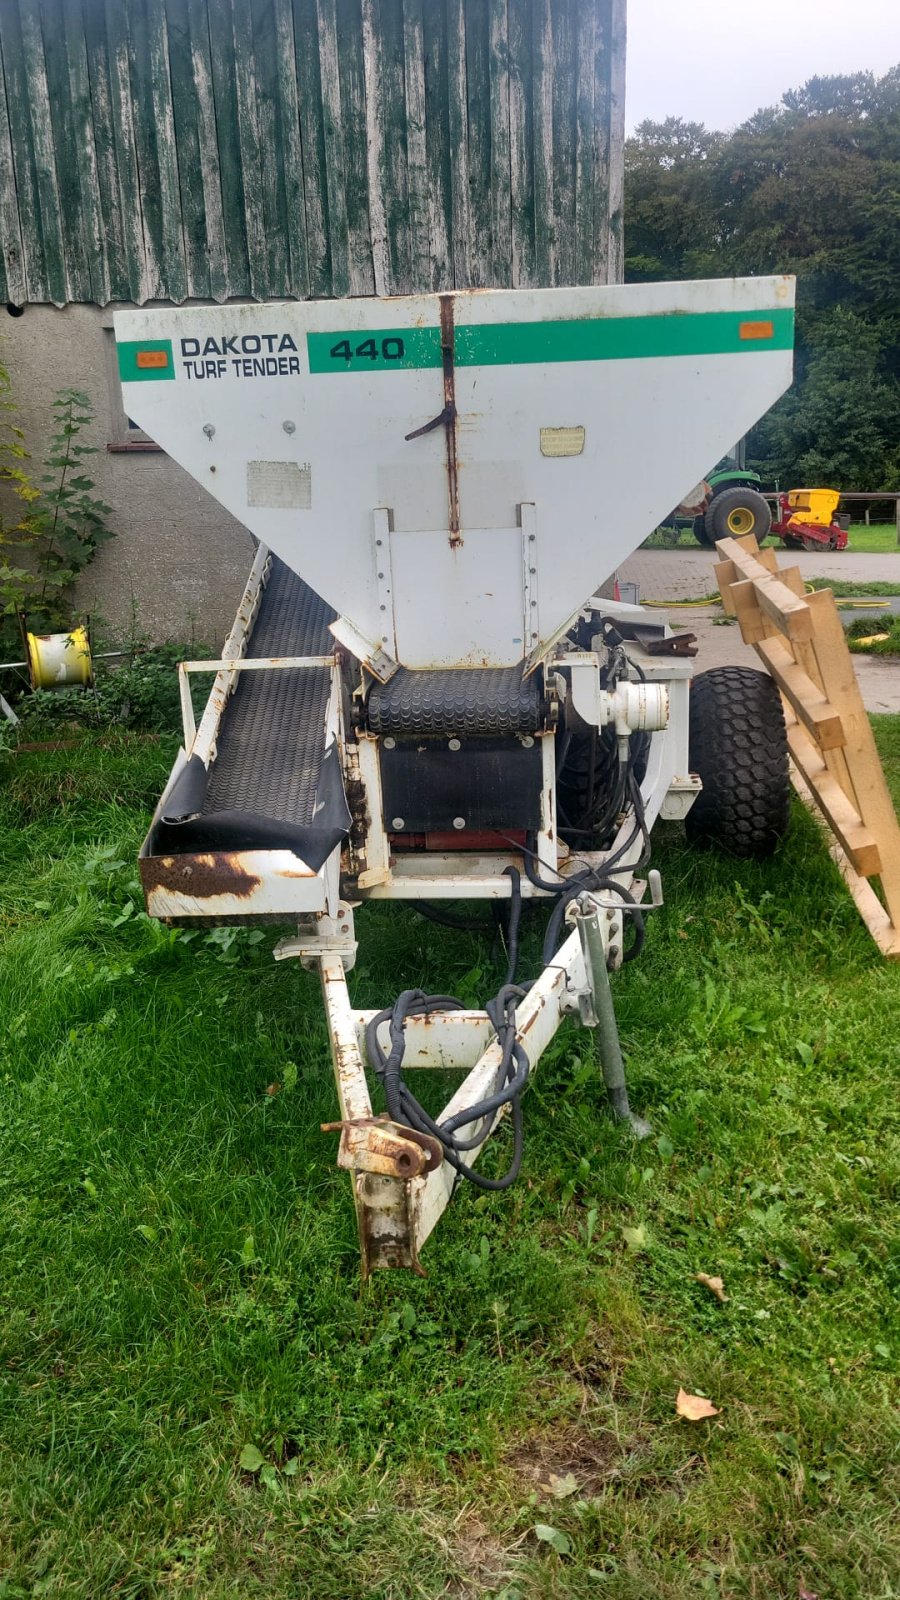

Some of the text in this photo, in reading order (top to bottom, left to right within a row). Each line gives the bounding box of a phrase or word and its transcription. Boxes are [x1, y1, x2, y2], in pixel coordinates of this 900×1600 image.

[180, 333, 298, 357] DAKOTA
[329, 337, 405, 362] 440
[183, 356, 300, 380] TURF TENDER
